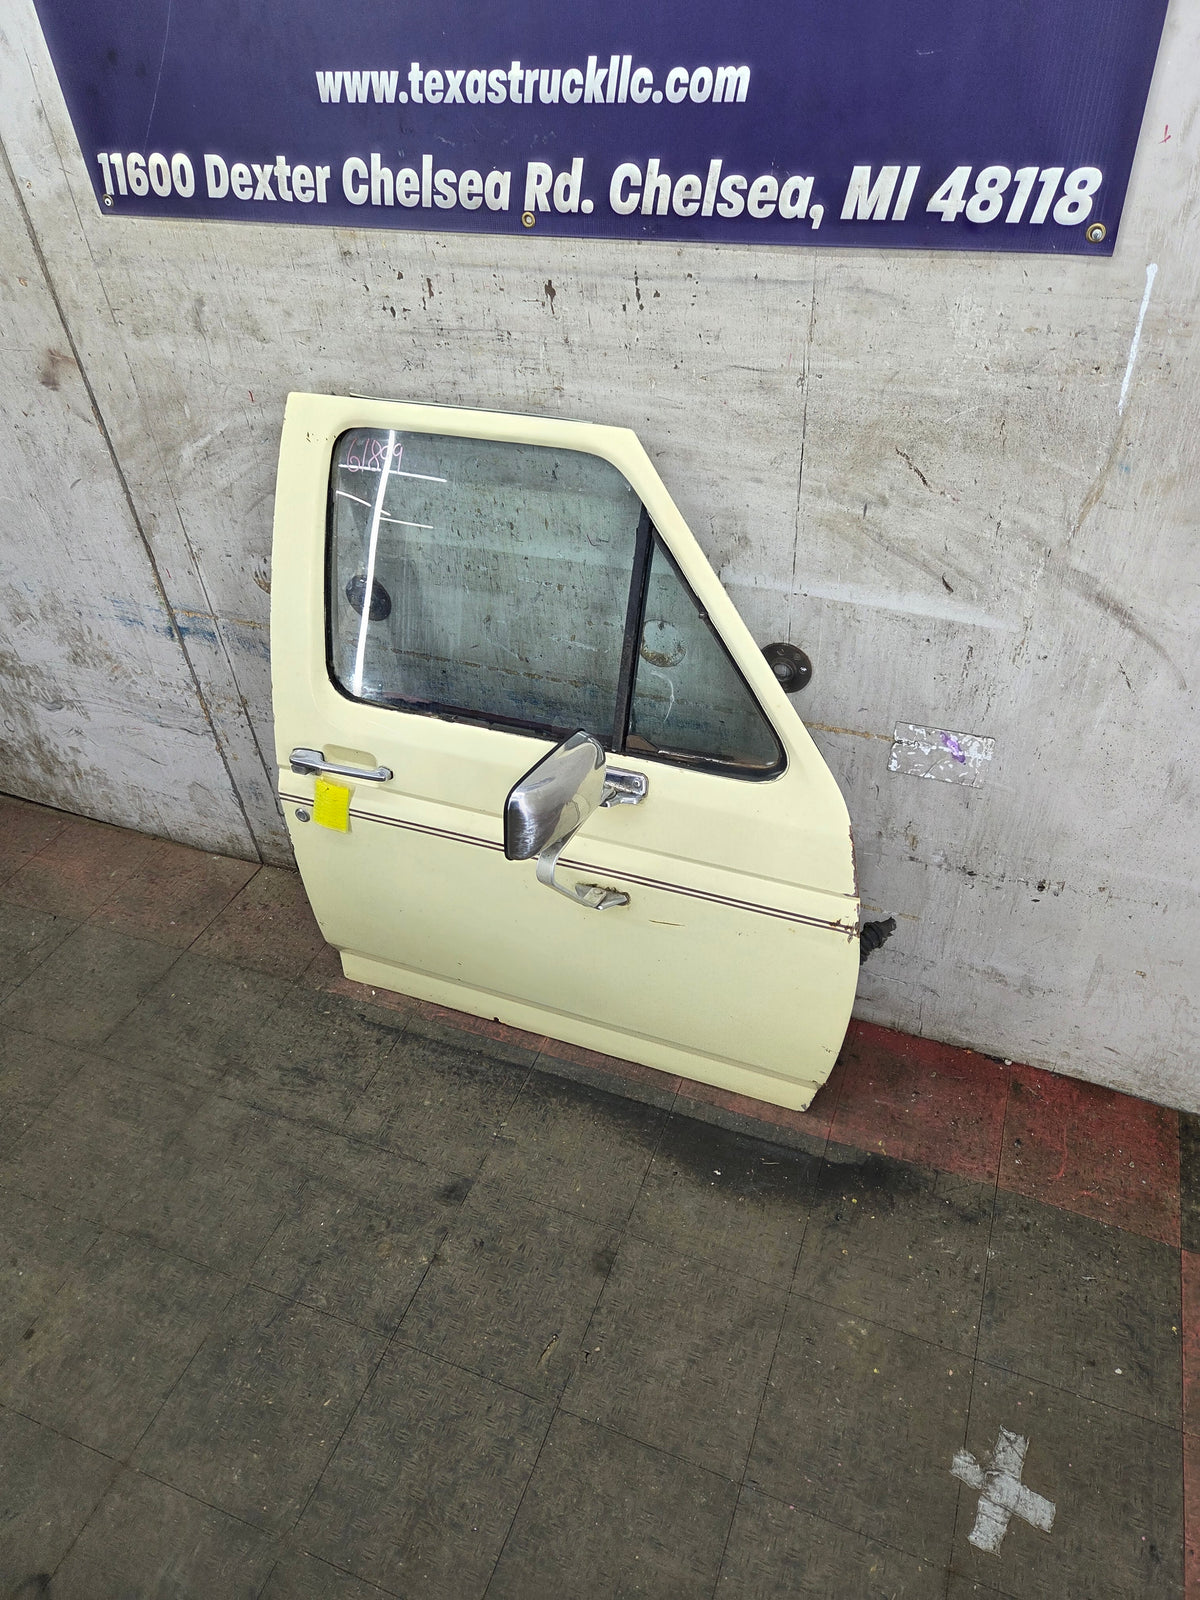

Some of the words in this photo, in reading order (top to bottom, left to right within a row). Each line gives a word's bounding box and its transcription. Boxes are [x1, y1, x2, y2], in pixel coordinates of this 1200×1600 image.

[315, 55, 751, 105] www.texastruckllc.com
[97, 152, 195, 197] 11600
[205, 153, 330, 204] Dexter
[341, 153, 511, 211] Chelsea
[523, 158, 594, 214] Rd.
[609, 158, 825, 230] Chelsea,
[840, 165, 921, 222] MI
[926, 166, 1103, 225] 48118
